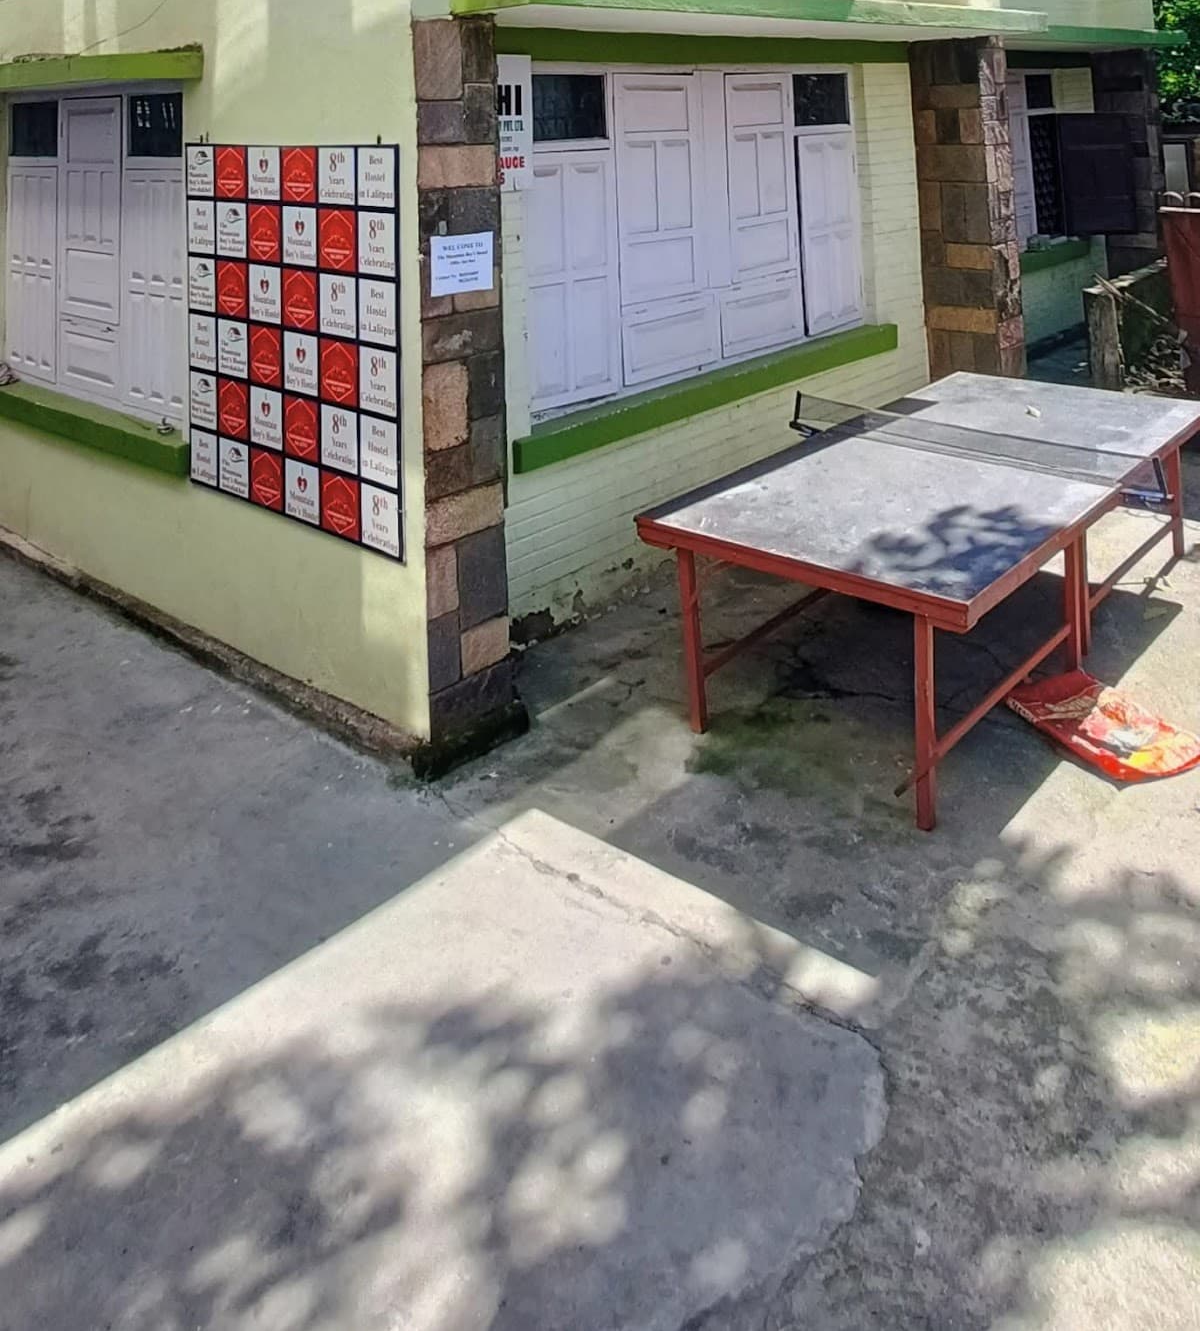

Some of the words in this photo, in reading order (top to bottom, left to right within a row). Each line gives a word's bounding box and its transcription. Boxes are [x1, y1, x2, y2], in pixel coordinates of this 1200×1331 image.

[329, 152, 345, 172] 8th
[369, 156, 383, 165] Best
[328, 176, 344, 185] Years
[365, 172, 385, 182] Hostel
[320, 190, 353, 200] Celebrating
[369, 219, 385, 239] 8th
[368, 243, 384, 253] Years
[360, 258, 394, 270] Celebrating
[331, 282, 346, 301] 8th
[370, 289, 384, 299] Best
[330, 305, 345, 316] Years
[366, 305, 387, 317] Hostel
[322, 318, 355, 333] Celebrating
[370, 356, 387, 377] 8th
[370, 380, 386, 391] Years
[360, 392, 395, 410] Celebrating
[332, 414, 347, 434] 8th
[372, 426, 386, 438] Best
[332, 437, 347, 449] Years
[368, 442, 388, 456] Hostel
[323, 449, 356, 468] Celebrating
[372, 494, 388, 516] 8th
[372, 519, 388, 533] Years
[363, 531, 398, 554] Celebrating
